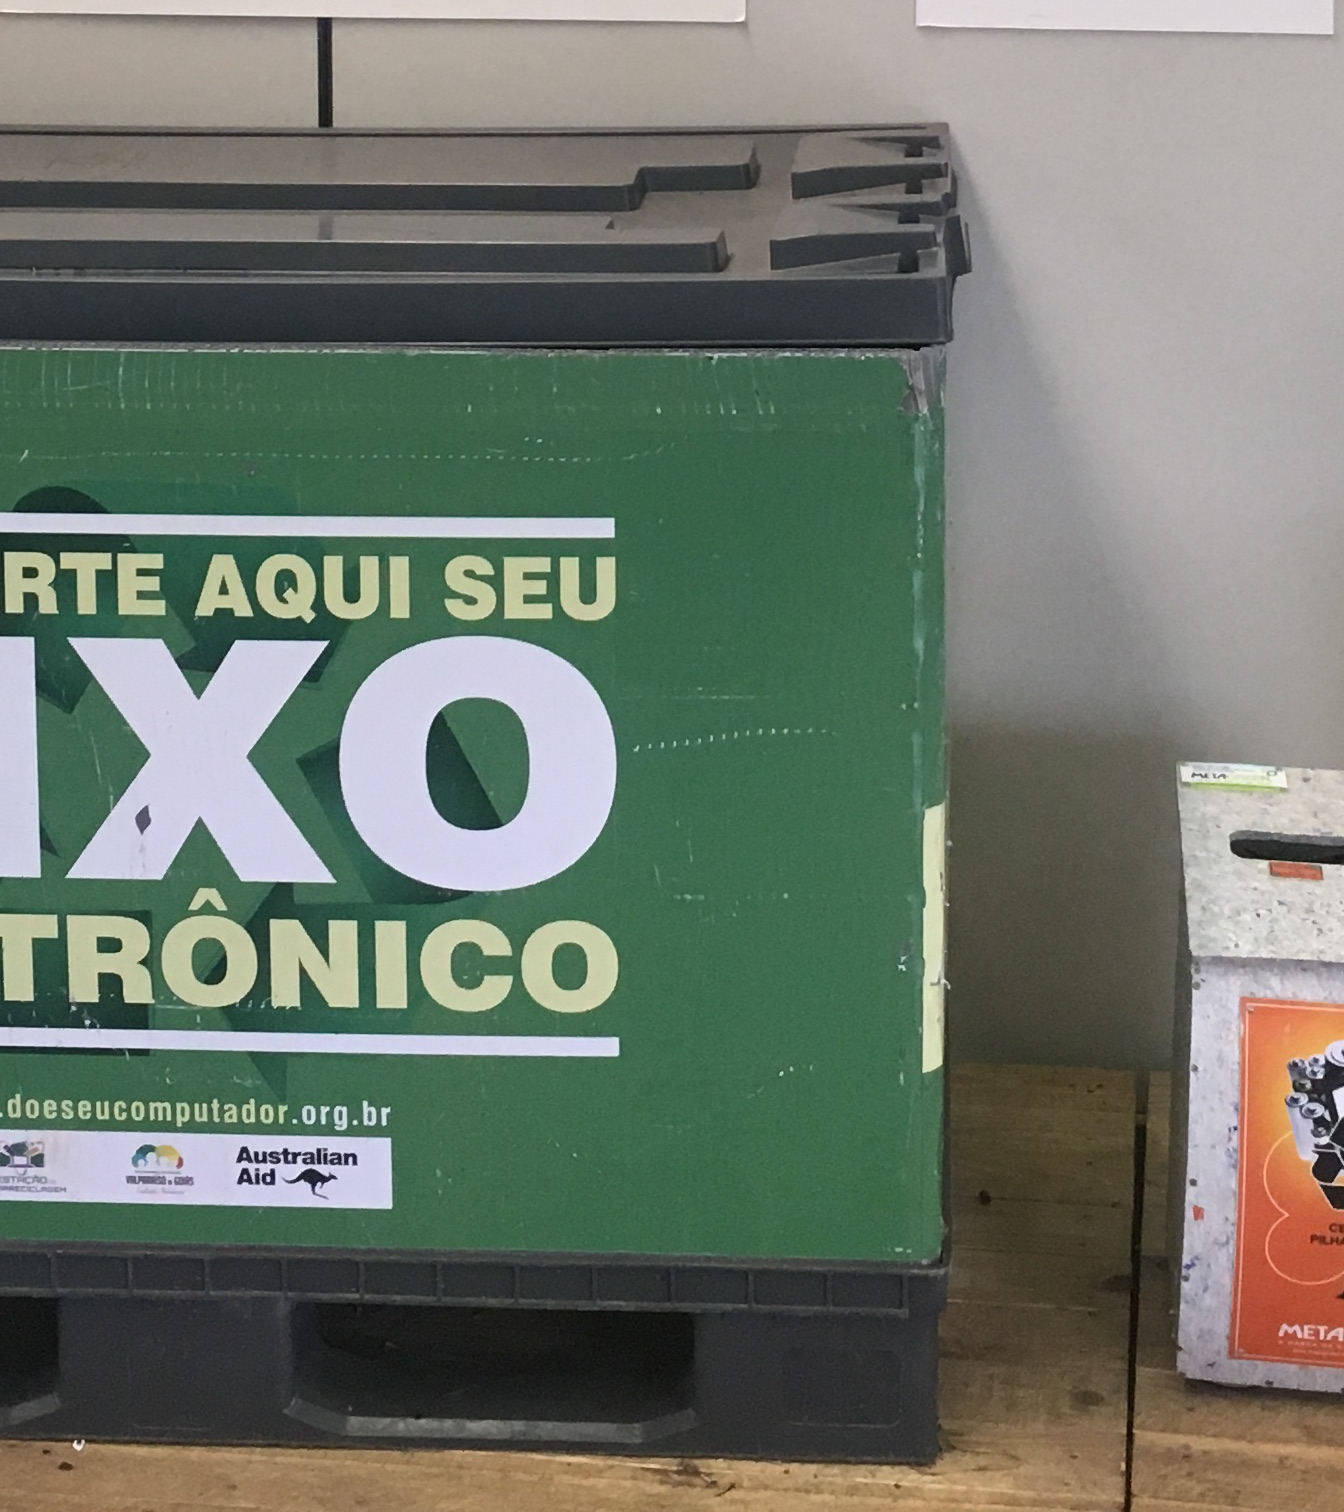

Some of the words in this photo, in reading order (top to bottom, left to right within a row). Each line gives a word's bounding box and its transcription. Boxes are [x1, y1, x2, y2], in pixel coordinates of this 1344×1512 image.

[195, 554, 410, 623] AQUI
[445, 555, 616, 621] SEU
[236, 1147, 357, 1165] Australian
[237, 1168, 275, 1185] Aid
